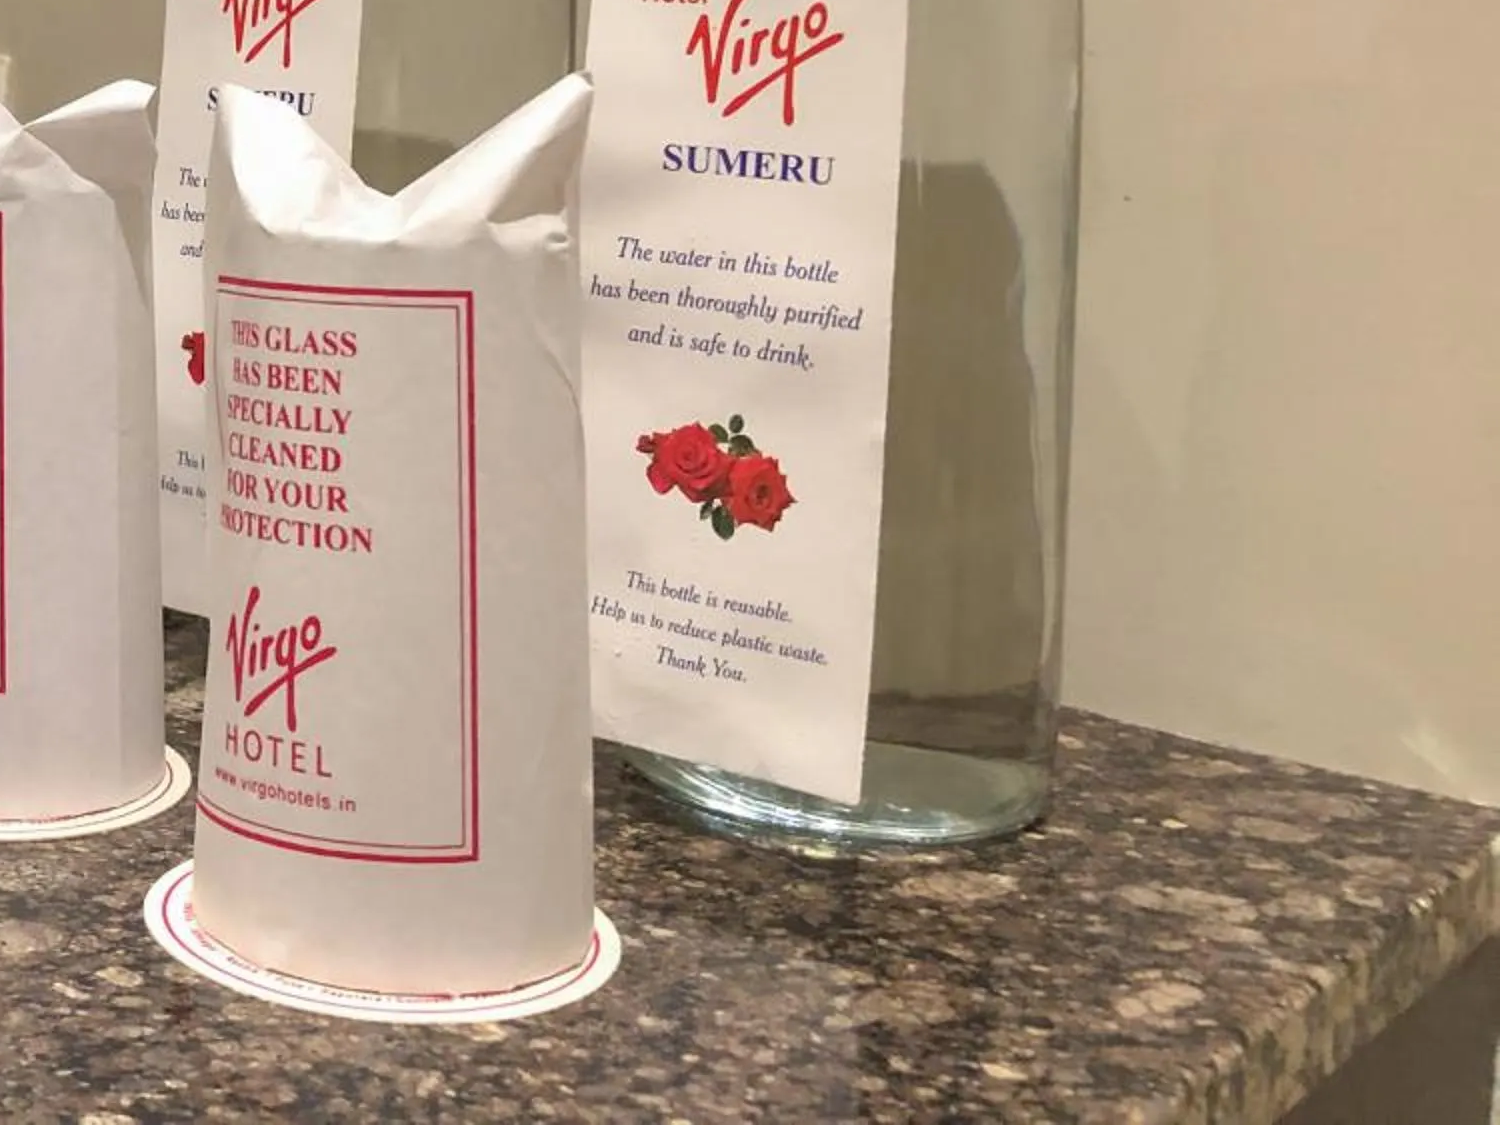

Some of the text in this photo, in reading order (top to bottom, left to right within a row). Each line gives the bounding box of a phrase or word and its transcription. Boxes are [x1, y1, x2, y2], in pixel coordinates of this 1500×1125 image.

[662, 143, 836, 186] SUMERU
[616, 236, 839, 284] The water in this bottle
[590, 275, 863, 331] has been thoroughly purified
[231, 319, 358, 358] THIS GLASS
[628, 325, 815, 371] and is safe to drink.
[233, 357, 342, 395] HAS BEEN
[227, 394, 352, 435] SPECIALLY
[228, 431, 342, 473] CLEANED
[227, 467, 349, 514] FOR YOUR
[221, 502, 373, 553] PROTECTION
[626, 570, 793, 623] This bottle is reusable.
[591, 595, 829, 666] Help us to reduce plastic waste.
[226, 586, 337, 732] Virgo
[656, 645, 748, 683] Thank You.
[225, 722, 333, 778] HOTEL
[215, 766, 357, 812] www.virgohotels.in
